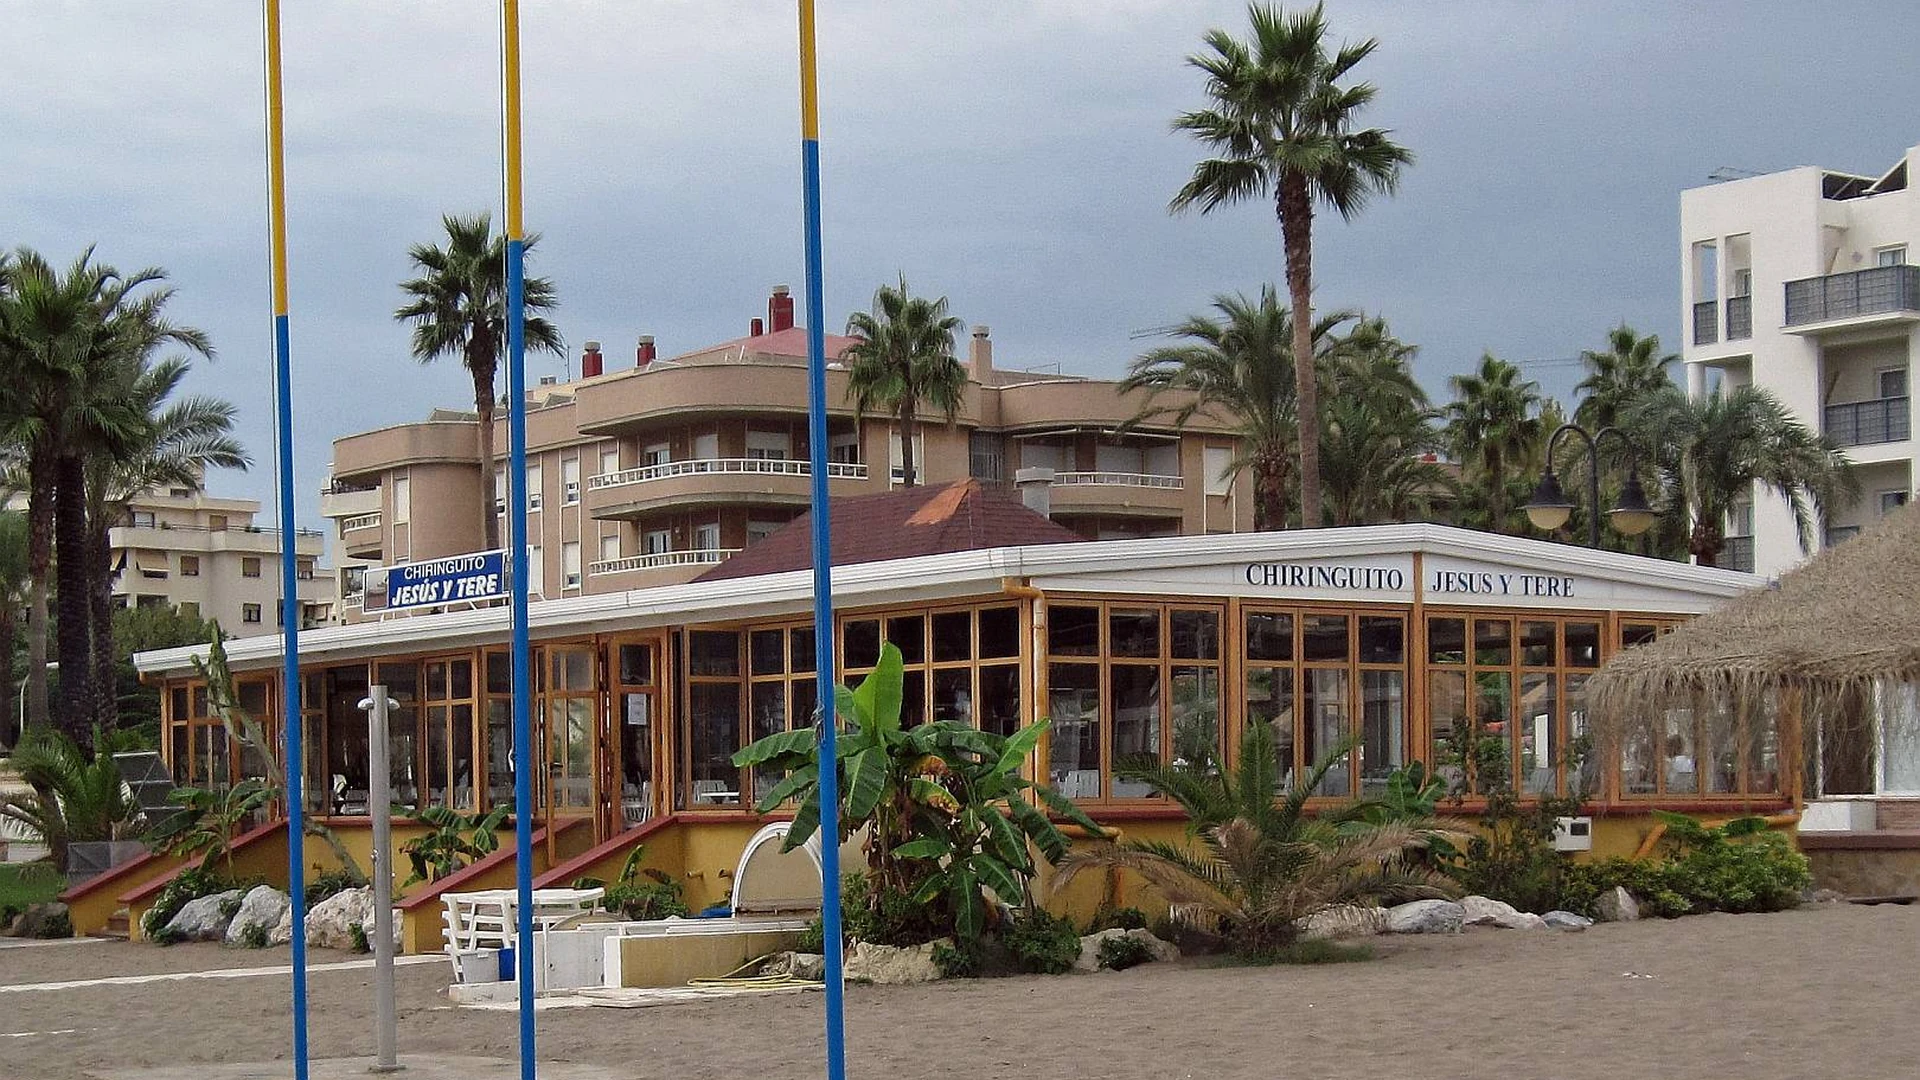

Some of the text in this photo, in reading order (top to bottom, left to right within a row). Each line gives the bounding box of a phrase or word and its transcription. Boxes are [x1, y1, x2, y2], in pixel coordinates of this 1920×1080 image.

[404, 556, 485, 579] CHIRINGUITO
[1246, 564, 1575, 598] CHIRINGUITO JESUS Y TERE
[392, 574, 498, 605] JESÚS Y TERE
